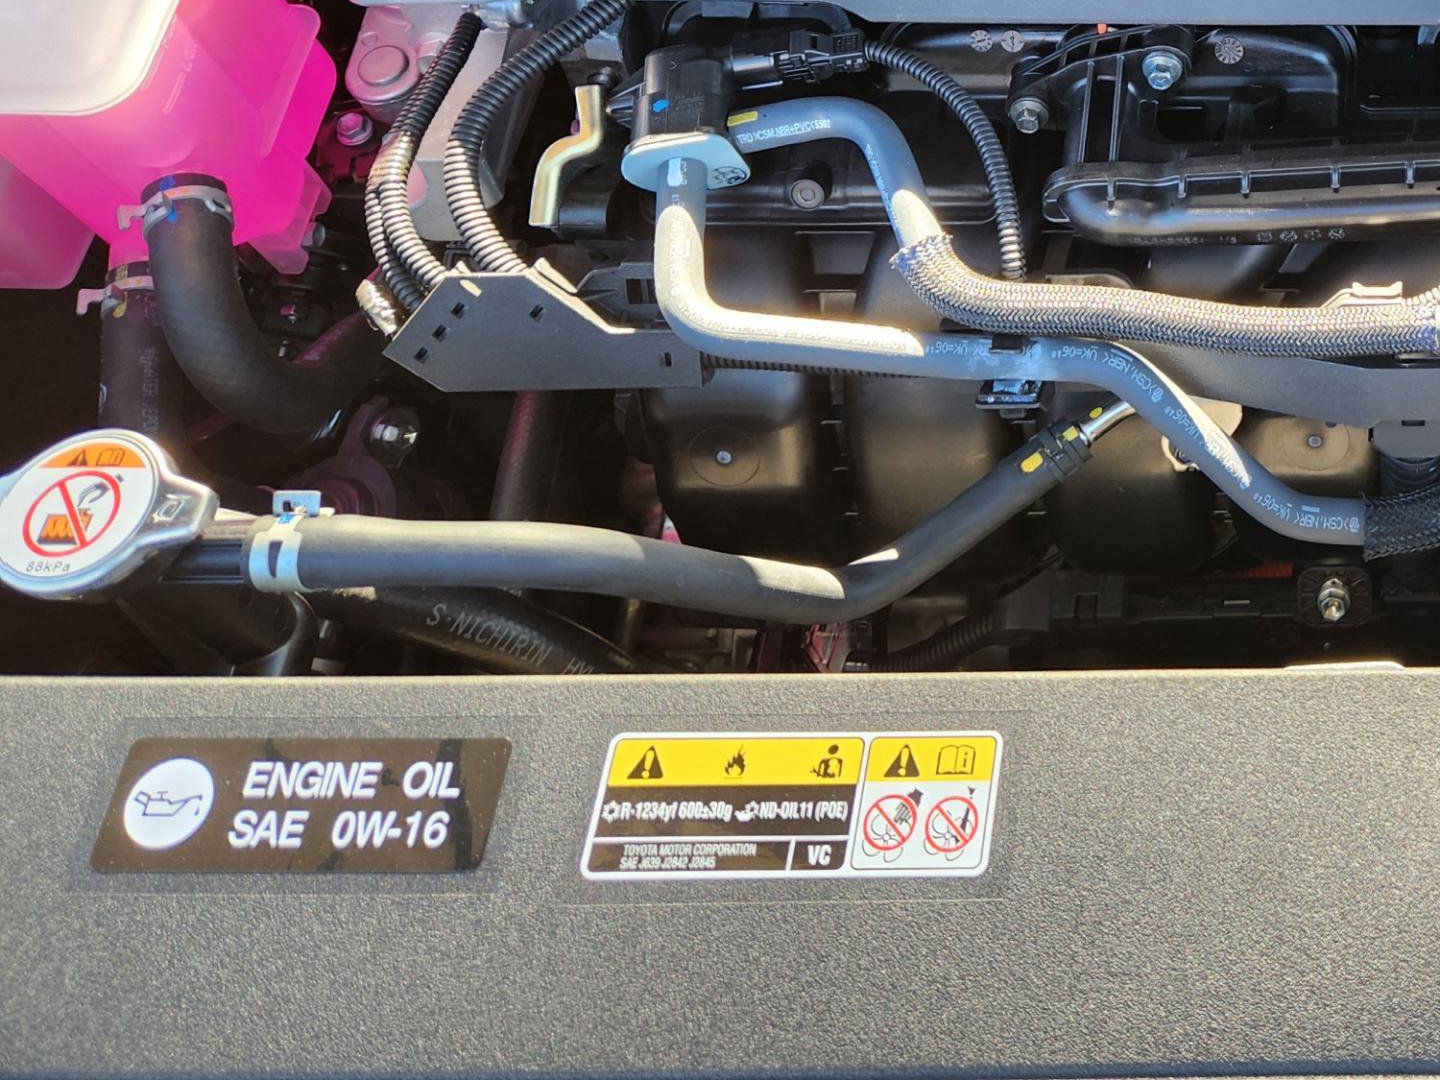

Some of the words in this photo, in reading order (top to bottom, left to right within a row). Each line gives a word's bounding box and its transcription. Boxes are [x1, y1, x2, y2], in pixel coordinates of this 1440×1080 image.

[25, 560, 71, 572] 88kPa
[242, 761, 383, 798] ENGINE
[402, 761, 461, 798] OIL
[815, 800, 848, 822] (POE)
[228, 809, 310, 848] SAE
[331, 810, 451, 848] 0W-16
[623, 844, 658, 856] TOYOTA
[659, 843, 693, 856] MOTOR
[693, 842, 757, 856] CORPORATION
[807, 844, 832, 866] VC
[619, 856, 638, 869] SAE
[638, 856, 661, 869] J639
[688, 856, 716, 869] J2845
